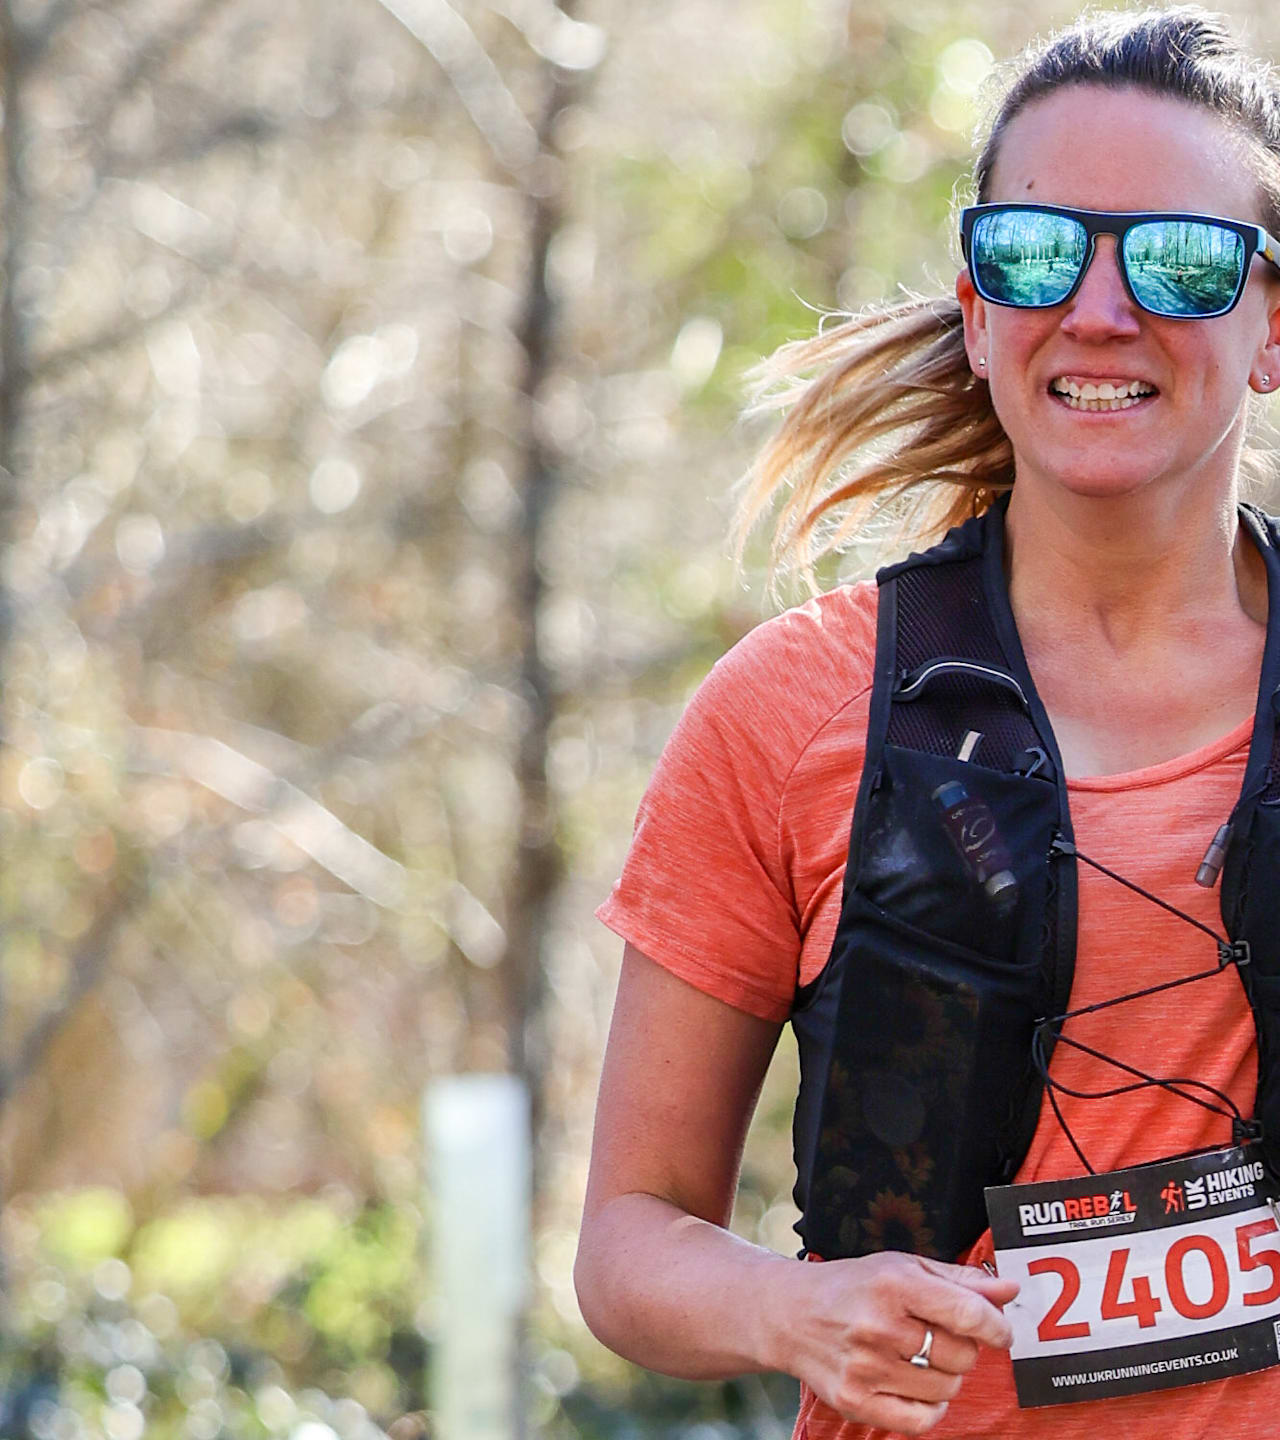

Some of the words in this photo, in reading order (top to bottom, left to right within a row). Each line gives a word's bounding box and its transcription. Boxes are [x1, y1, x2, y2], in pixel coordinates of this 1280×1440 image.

[1207, 1161, 1264, 1192] HIKING
[1019, 1190, 1137, 1226] RUNREBL
[1184, 1176, 1207, 1210] UK
[1209, 1184, 1255, 1206] EVENTS
[1107, 1215, 1132, 1225] SERIES
[1052, 1348, 1239, 1388] WWW.UKRUNNINGEVENTS.CO.UK
